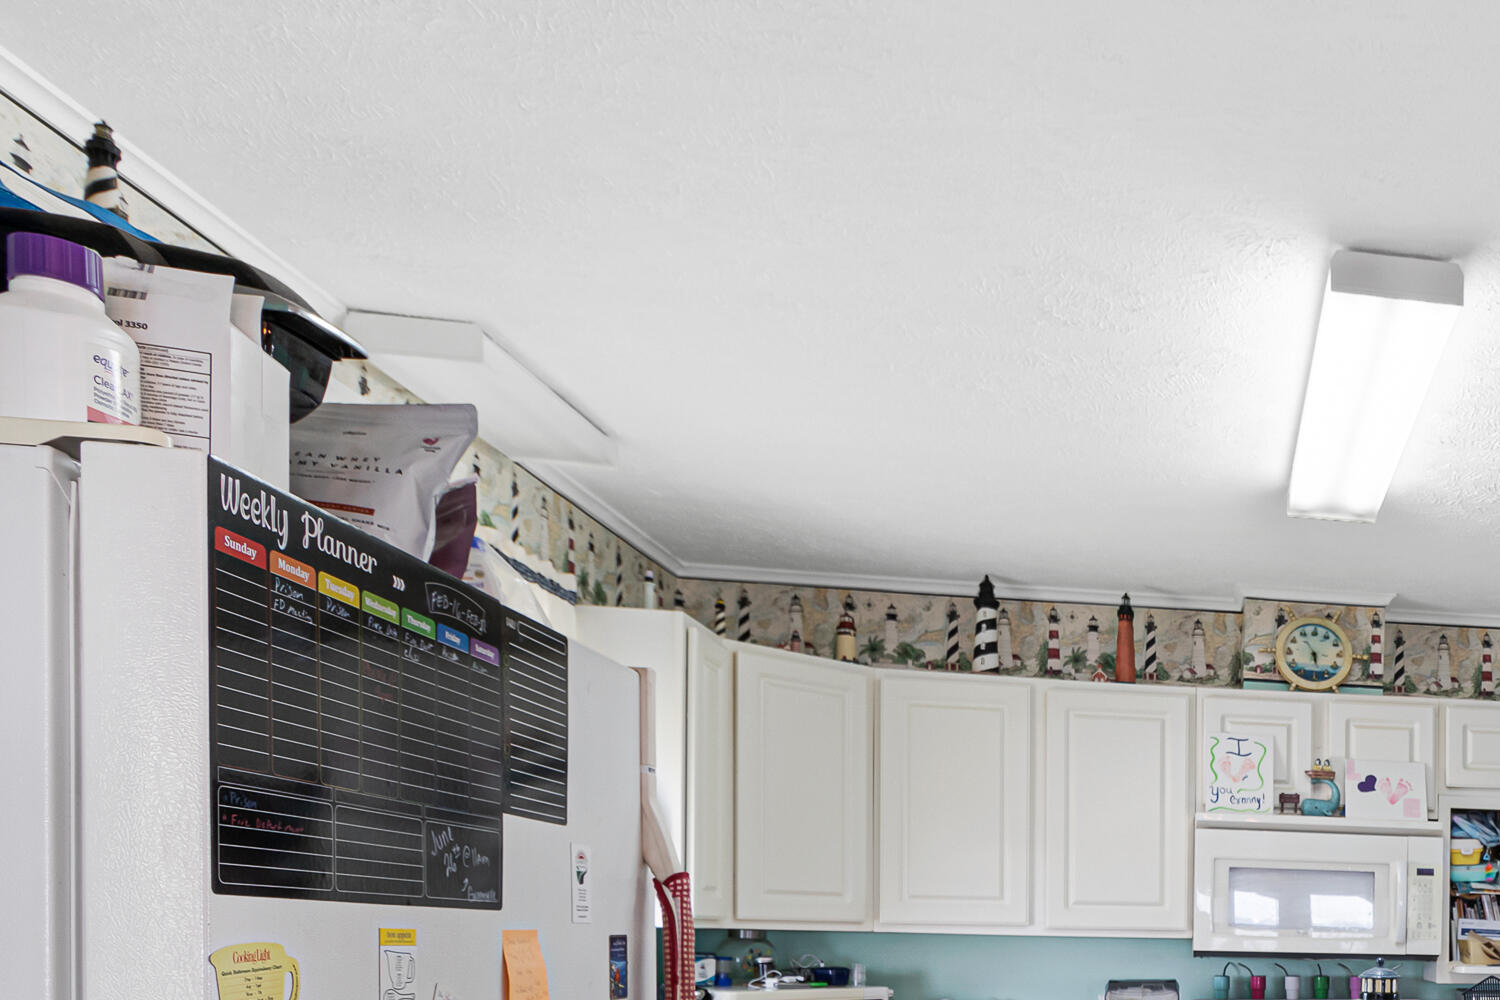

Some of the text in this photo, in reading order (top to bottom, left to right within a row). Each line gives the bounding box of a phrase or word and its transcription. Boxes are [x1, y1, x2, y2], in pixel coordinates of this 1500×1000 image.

[124, 320, 148, 330] 3350
[220, 472, 378, 574] Weekly Planner
[224, 535, 257, 560] Sunday
[277, 557, 310, 583] Monday
[325, 578, 355, 601] Tuesday
[1226, 737, 1253, 757] I
[232, 948, 271, 964] Cooking Light
